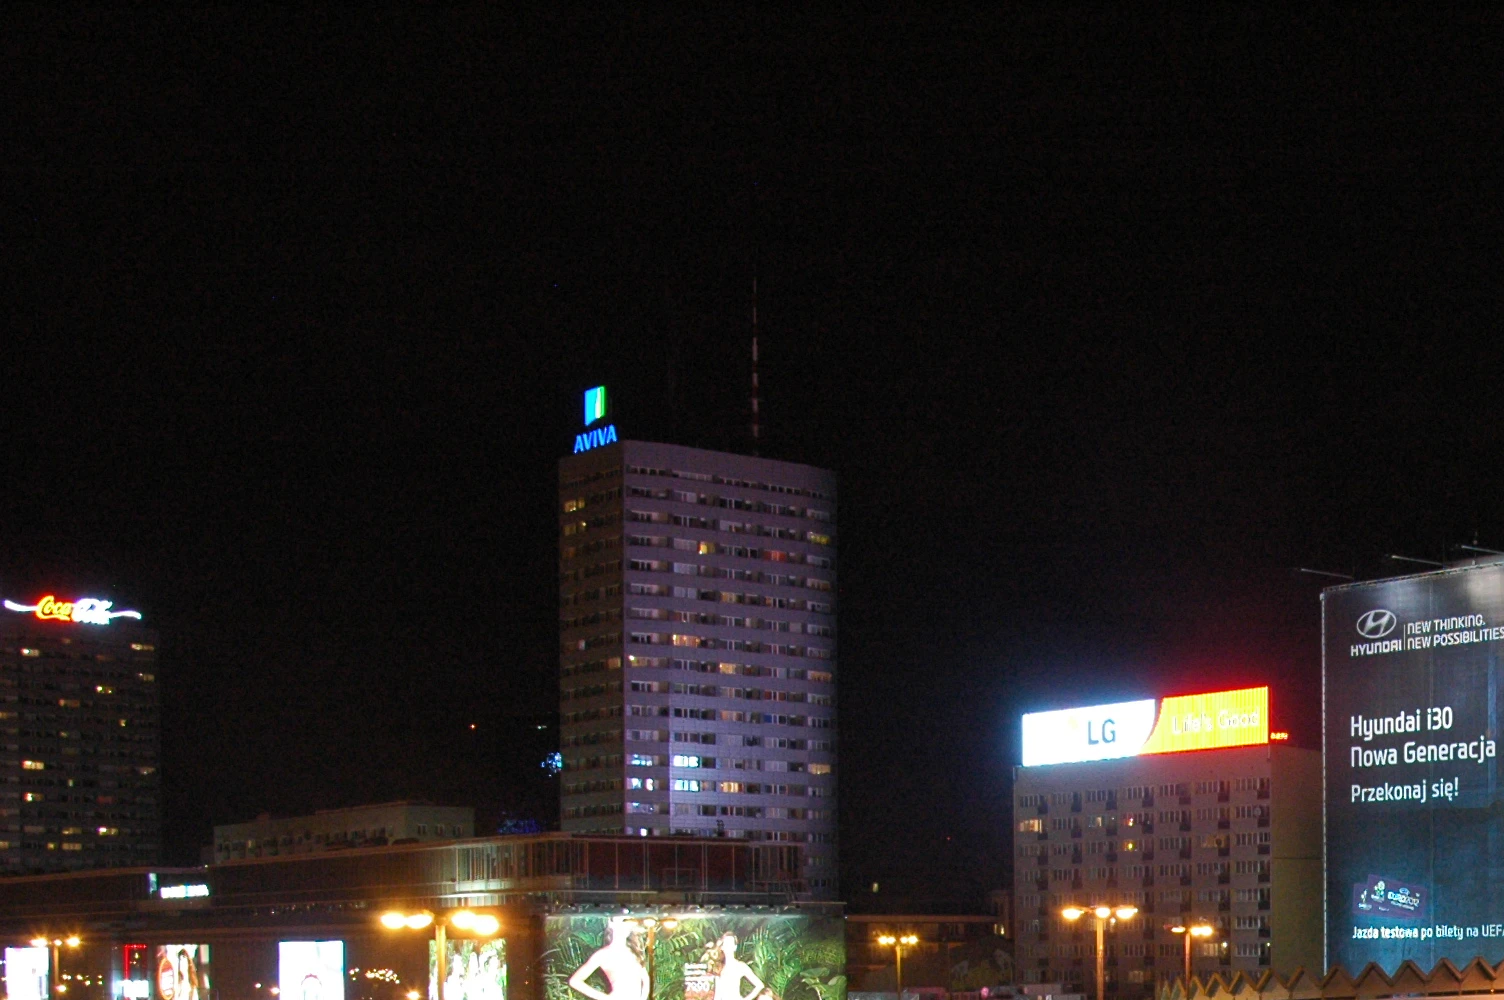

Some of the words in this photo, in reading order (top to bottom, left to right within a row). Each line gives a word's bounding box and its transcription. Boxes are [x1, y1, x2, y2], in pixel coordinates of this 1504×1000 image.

[574, 424, 617, 454] AVIVA
[1407, 620, 1432, 634] NEW
[1434, 614, 1486, 632] THINKING.
[1350, 639, 1402, 657] HYUNDAI
[1407, 635, 1431, 650] NEW
[1087, 718, 1117, 745] LG
[1351, 708, 1421, 741] Hyundai
[1427, 706, 1453, 730] i30
[1351, 746, 1397, 767] Nowa
[1403, 735, 1496, 764] Generacja
[1351, 779, 1427, 804] Przekonaj
[1431, 777, 1459, 801] się!
[1352, 926, 1379, 940] Jazda
[1380, 925, 1419, 939] testowa
[1421, 928, 1433, 941] po
[1435, 925, 1464, 940] bilety
[1466, 927, 1479, 937] na
